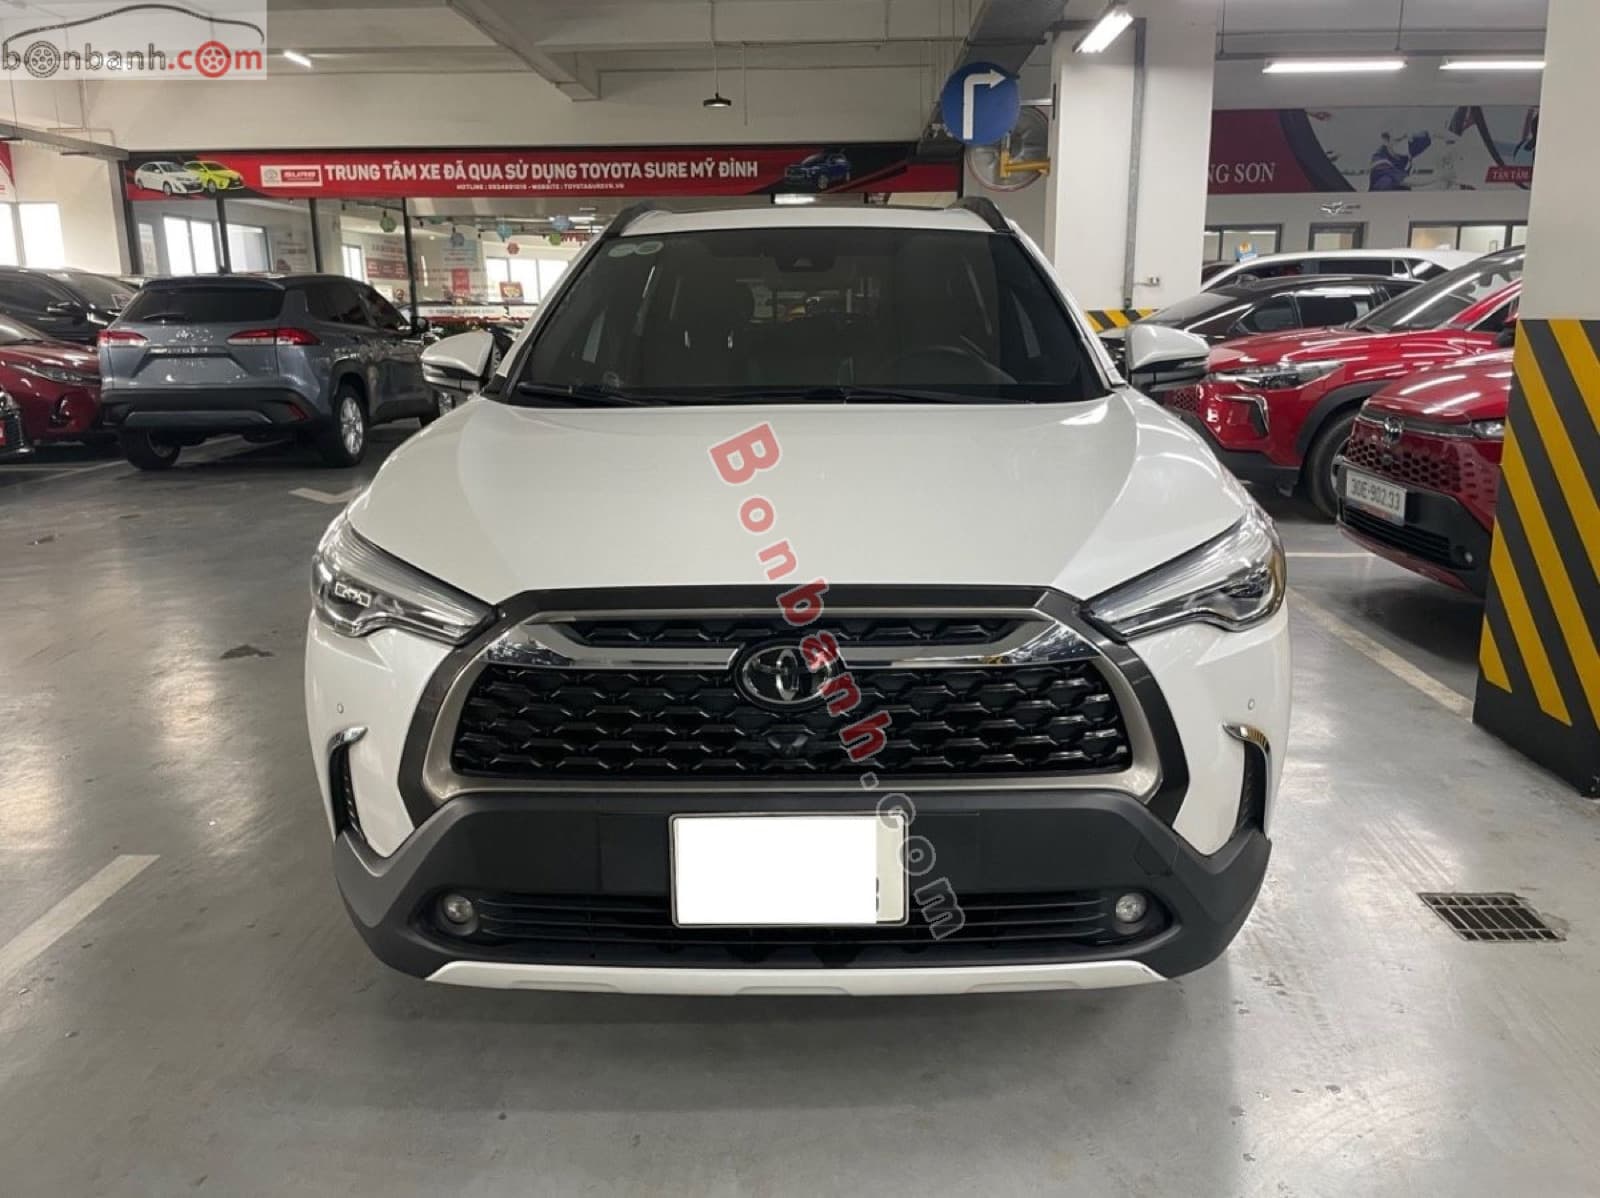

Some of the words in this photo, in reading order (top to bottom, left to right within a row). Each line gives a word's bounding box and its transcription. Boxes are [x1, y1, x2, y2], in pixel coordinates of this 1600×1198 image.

[324, 163, 381, 181] TRUNG
[382, 159, 417, 180] TÂM
[419, 163, 441, 180] XE
[443, 159, 467, 180] ĐÃ
[468, 163, 504, 181] QUA
[505, 158, 529, 180] SỬ
[531, 162, 578, 184] DỤNG
[579, 161, 643, 179] TOYOTA
[644, 160, 689, 179] SURE
[690, 156, 715, 178] MỸ
[717, 156, 759, 178] ĐÌNH
[456, 183, 484, 191] HOTLINE
